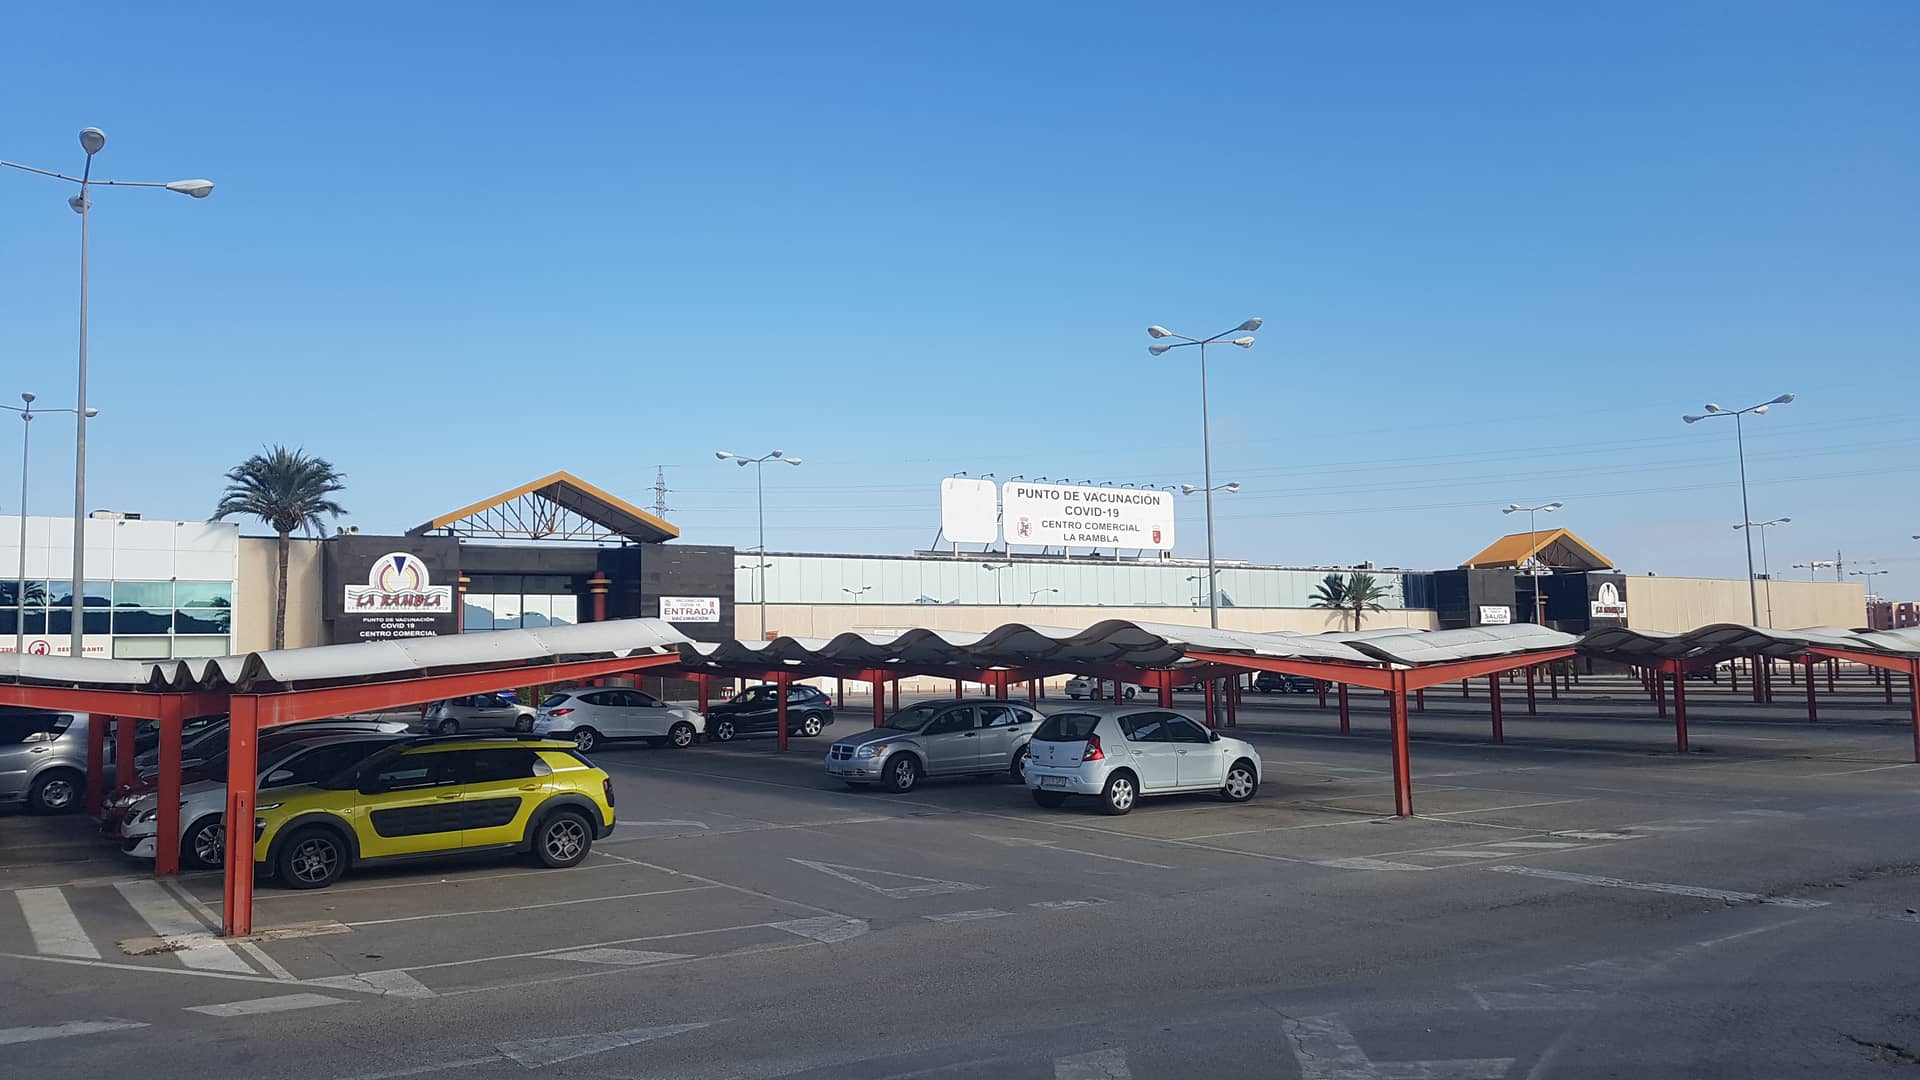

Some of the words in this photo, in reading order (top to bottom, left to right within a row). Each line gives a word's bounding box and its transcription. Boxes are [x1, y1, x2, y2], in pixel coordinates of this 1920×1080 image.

[1017, 488, 1060, 500] PUNTO
[1064, 491, 1080, 501] DE
[1083, 492, 1160, 505] VACUNACIÓN
[1065, 506, 1119, 518] COVID-19
[1041, 520, 1082, 530] CENTRO
[1085, 522, 1140, 532] COMERCIAL
[1063, 534, 1076, 542] LA
[1078, 534, 1119, 543] RAMBLA
[356, 594, 375, 607] LA
[380, 594, 441, 607] RAMBLA
[664, 607, 716, 615] ENTRADA
